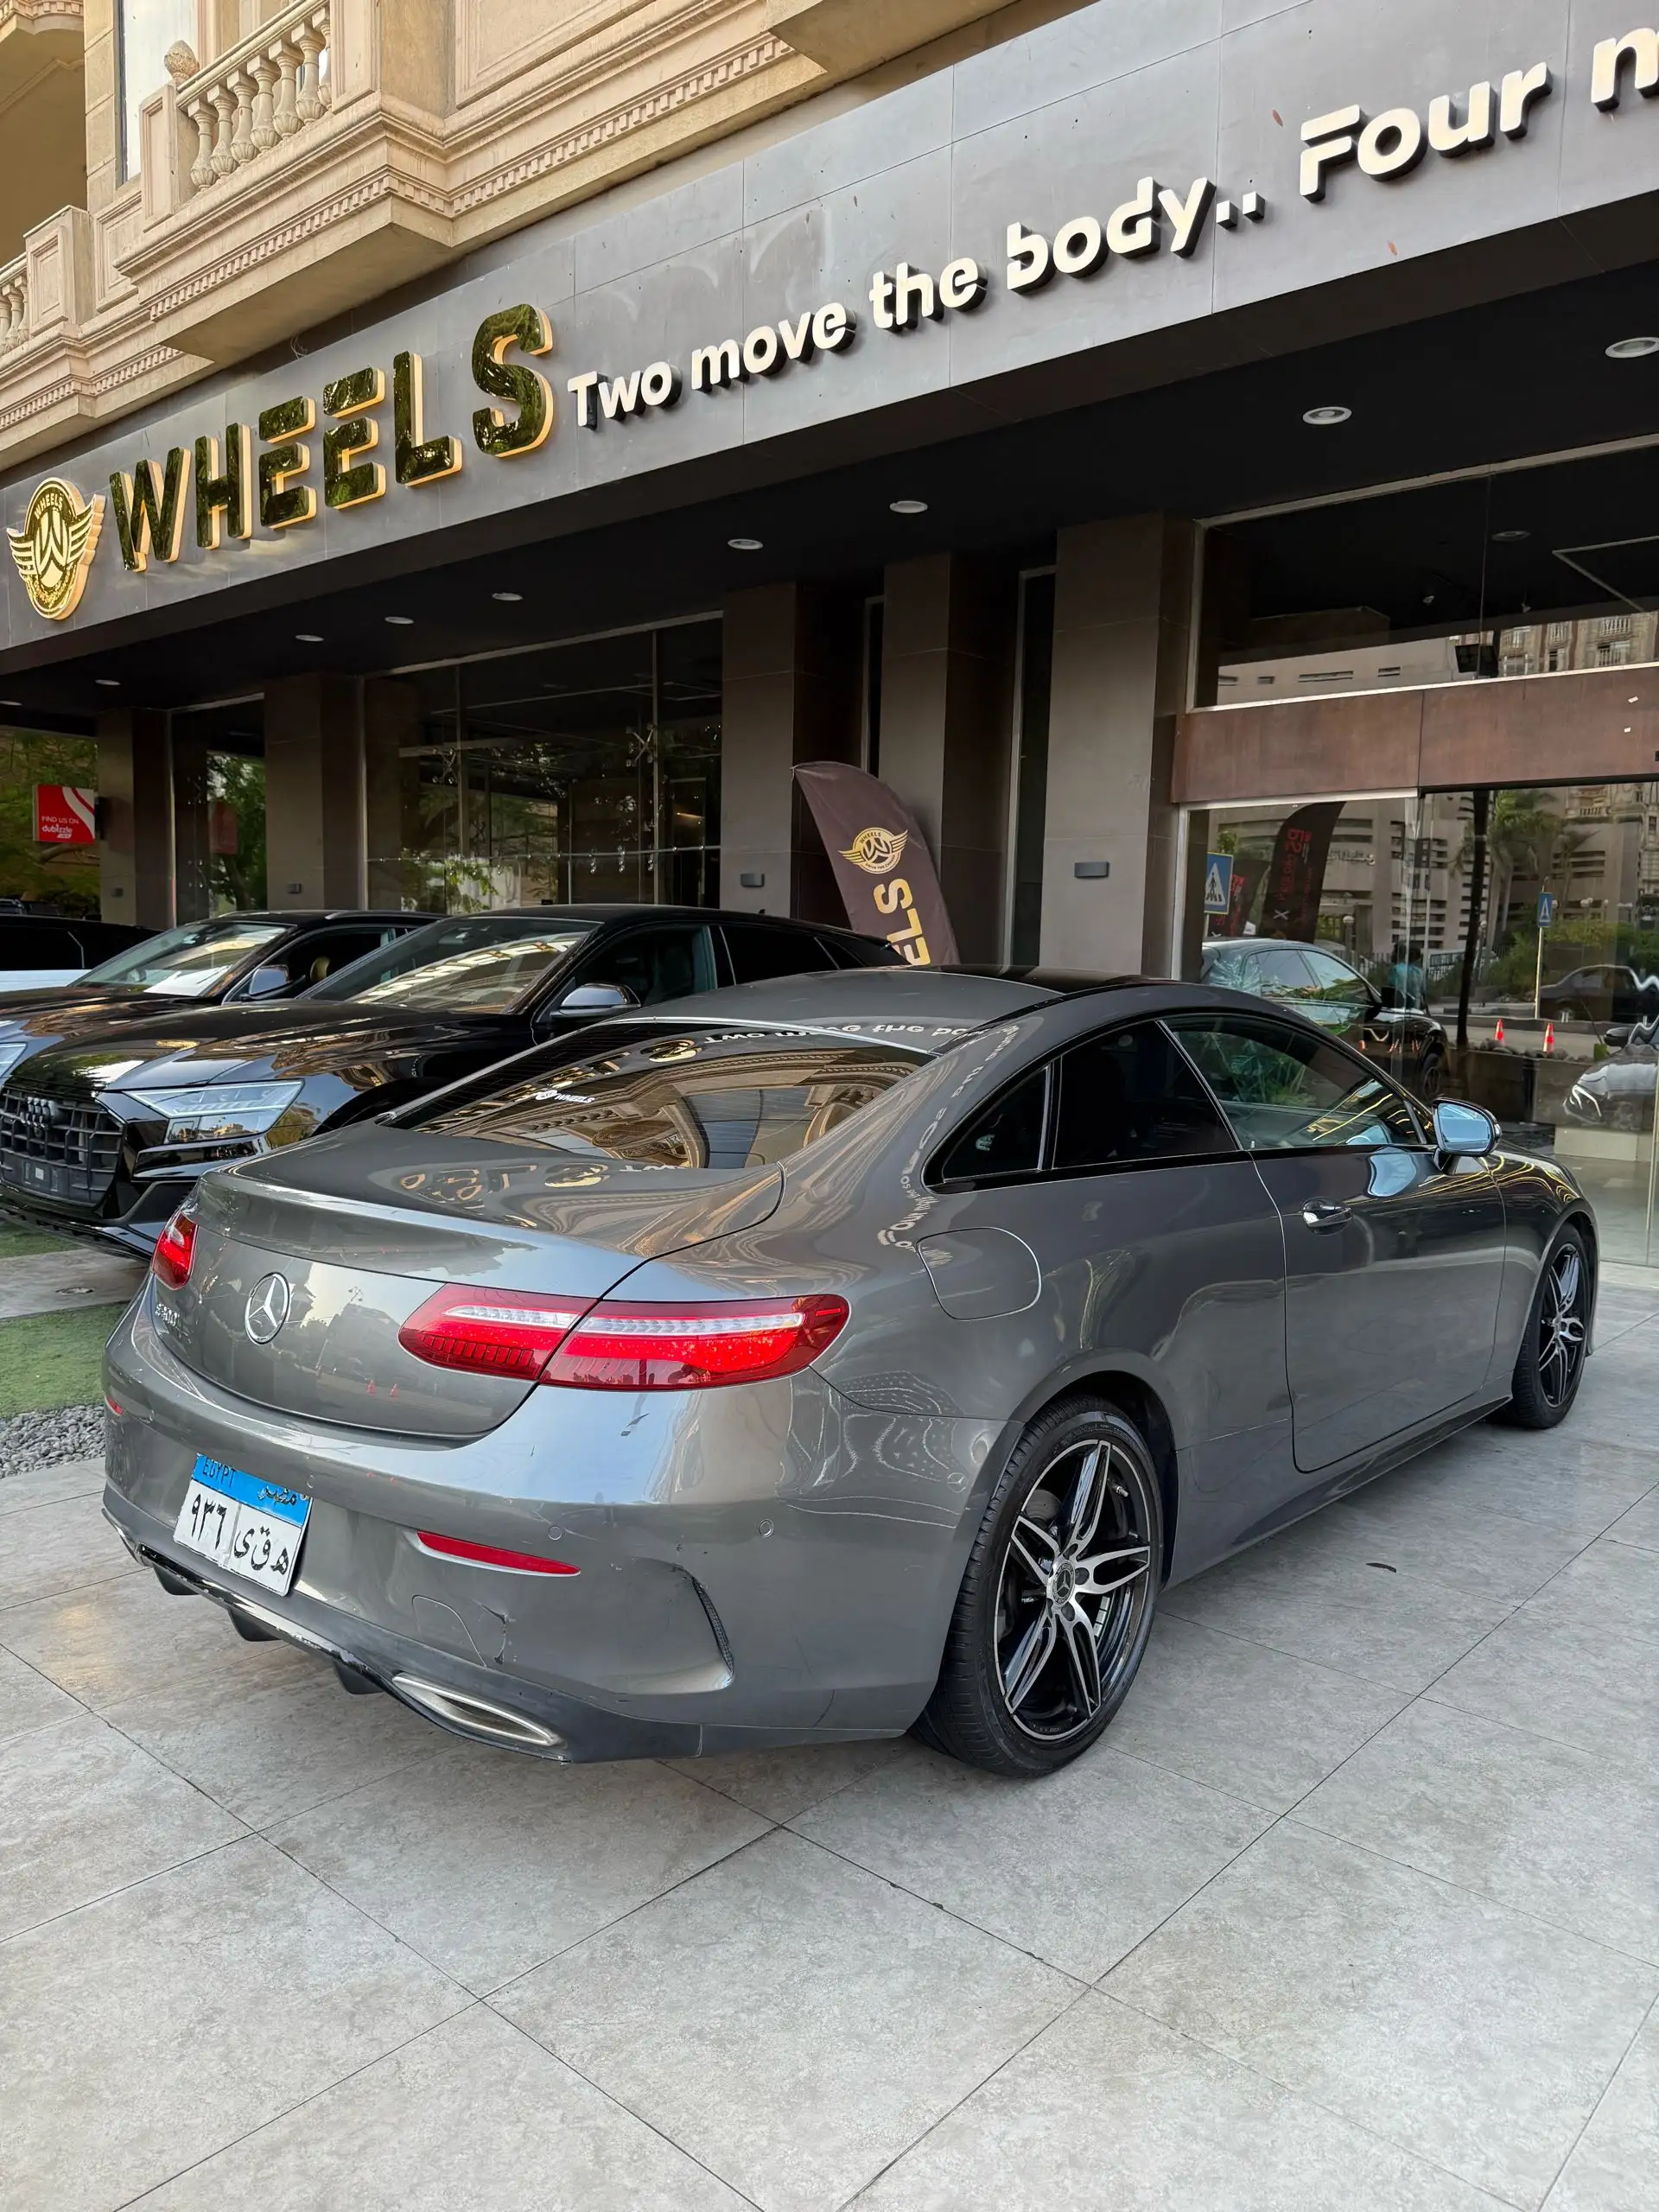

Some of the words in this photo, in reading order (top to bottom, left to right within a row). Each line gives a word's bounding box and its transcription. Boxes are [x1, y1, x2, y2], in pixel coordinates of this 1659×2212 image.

[567, 361, 679, 430] Two
[691, 302, 855, 392] move
[869, 257, 987, 332] the
[1300, 62, 1552, 203] Four
[109, 303, 553, 572] WHEELS
[35, 493, 63, 519] WHEELS
[860, 832, 881, 843] WHEELS
[202, 1457, 238, 1487] EGYPT
